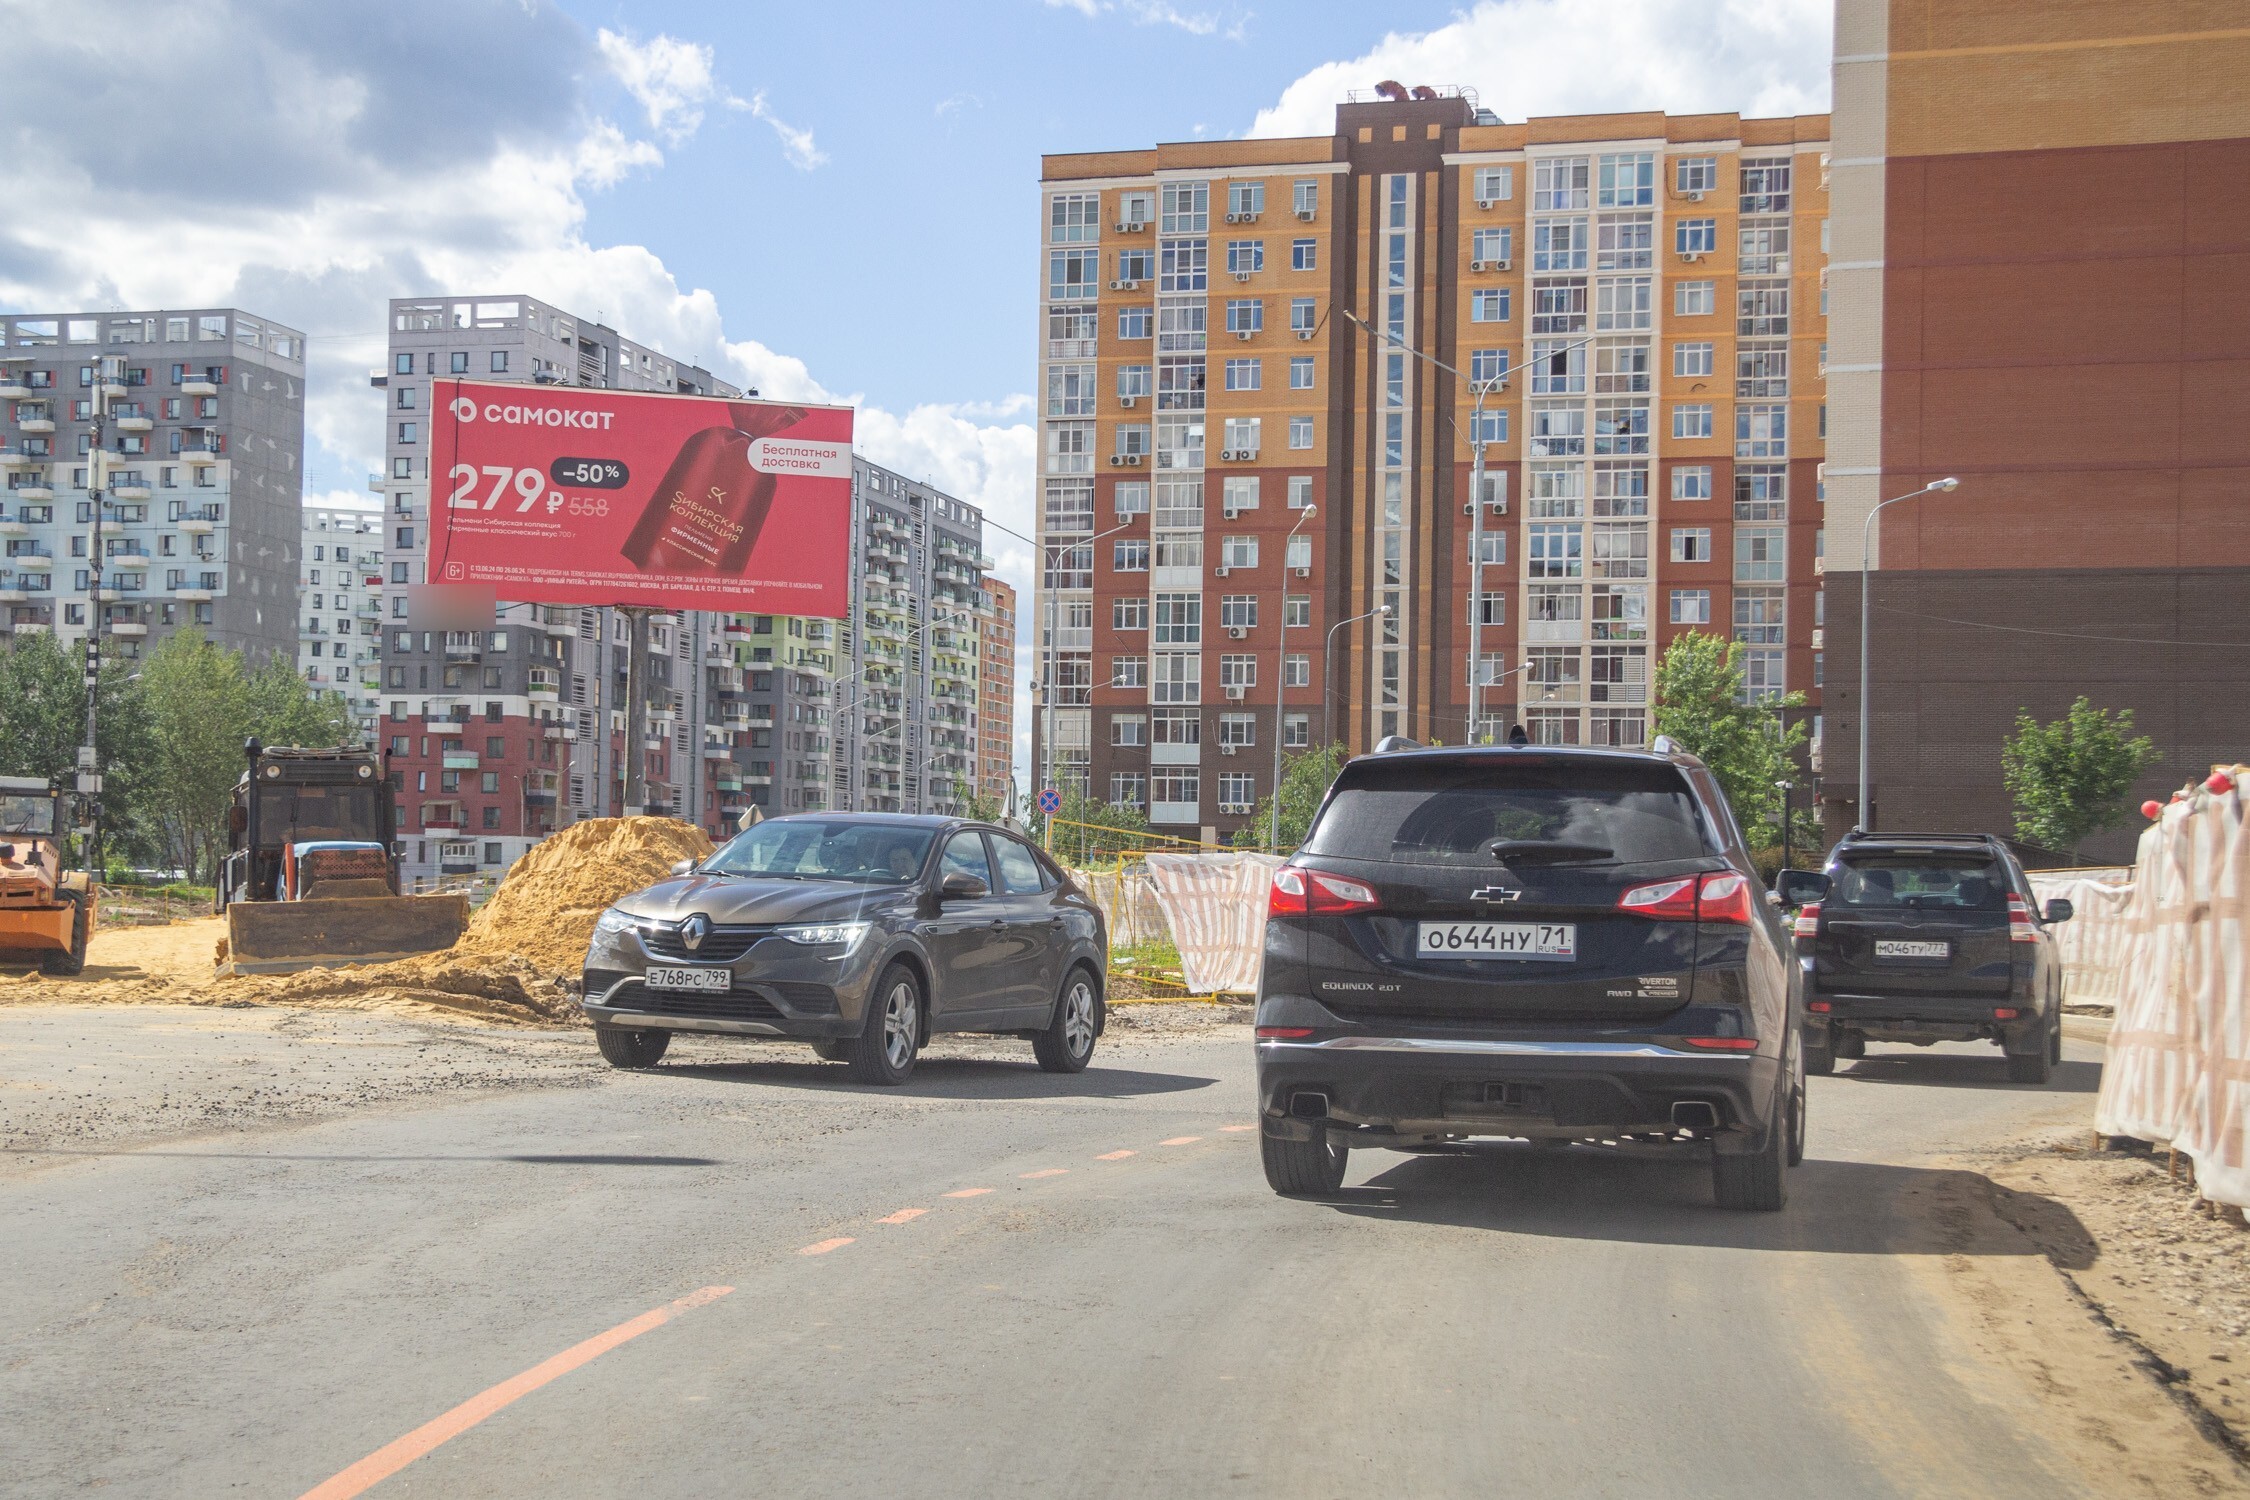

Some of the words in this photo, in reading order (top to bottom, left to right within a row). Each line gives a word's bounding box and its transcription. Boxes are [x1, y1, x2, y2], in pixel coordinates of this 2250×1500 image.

[484, 404, 614, 430] самокат
[762, 444, 837, 458] Бесплатная
[762, 458, 820, 469] доставка
[447, 516, 482, 525] Пельмени
[483, 518, 523, 528] Сибирская
[524, 521, 561, 529] коллекция
[670, 502, 739, 543] КОЛЛЕКЦИЯ
[447, 525, 489, 534] Фирменные
[490, 528, 541, 536] классический
[671, 526, 720, 555] ФИРМЕННЫЕ
[449, 565, 461, 577] 6+
[1540, 926, 1565, 945] 71
[1538, 945, 1557, 953] RUS
[705, 970, 727, 983] 799
[1638, 977, 1676, 985] RIVERTON
[1322, 982, 1374, 990] EQUINOX
